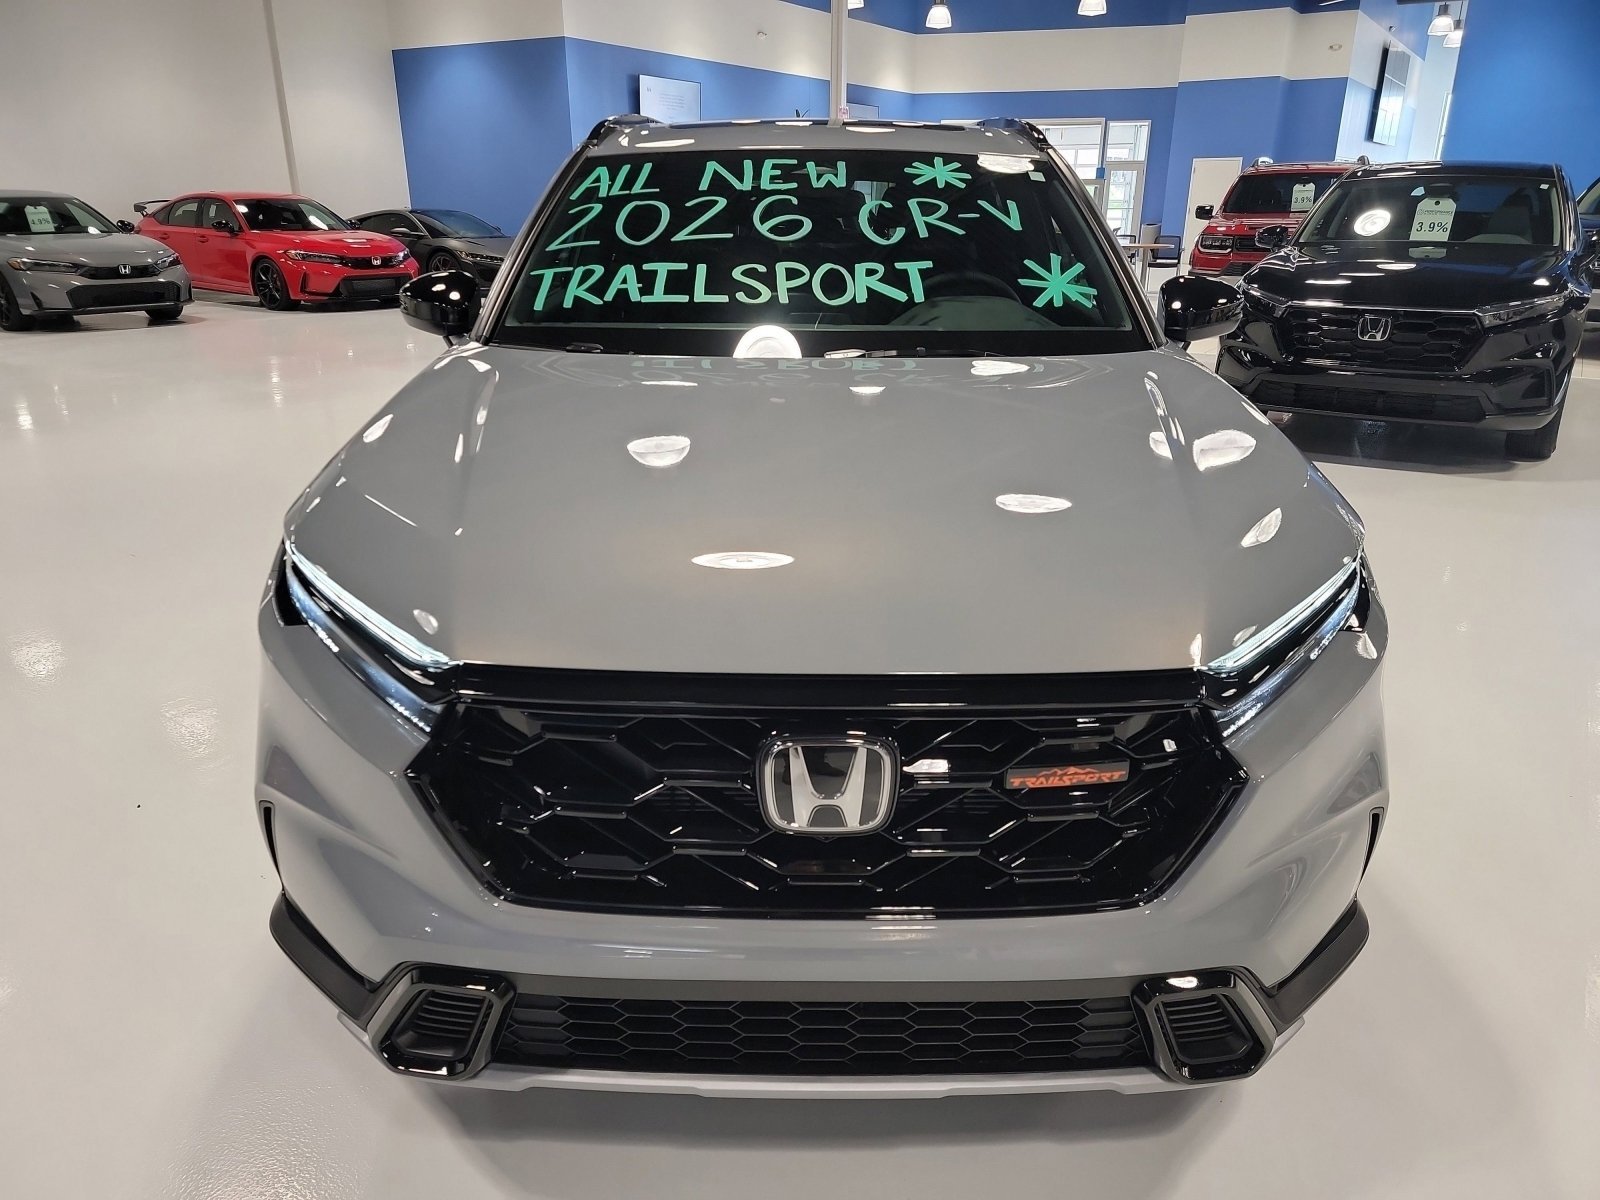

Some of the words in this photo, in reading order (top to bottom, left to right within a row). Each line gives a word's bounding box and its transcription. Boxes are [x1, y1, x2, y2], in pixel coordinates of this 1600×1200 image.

[569, 162, 660, 201] ALL
[699, 158, 847, 191] NEW
[545, 195, 812, 252] 2026
[858, 197, 1022, 245] CR-V
[1415, 221, 1449, 233] 3.9%
[529, 260, 934, 311] TRAILSPORT
[1009, 771, 1126, 789] TRAILSPORT
